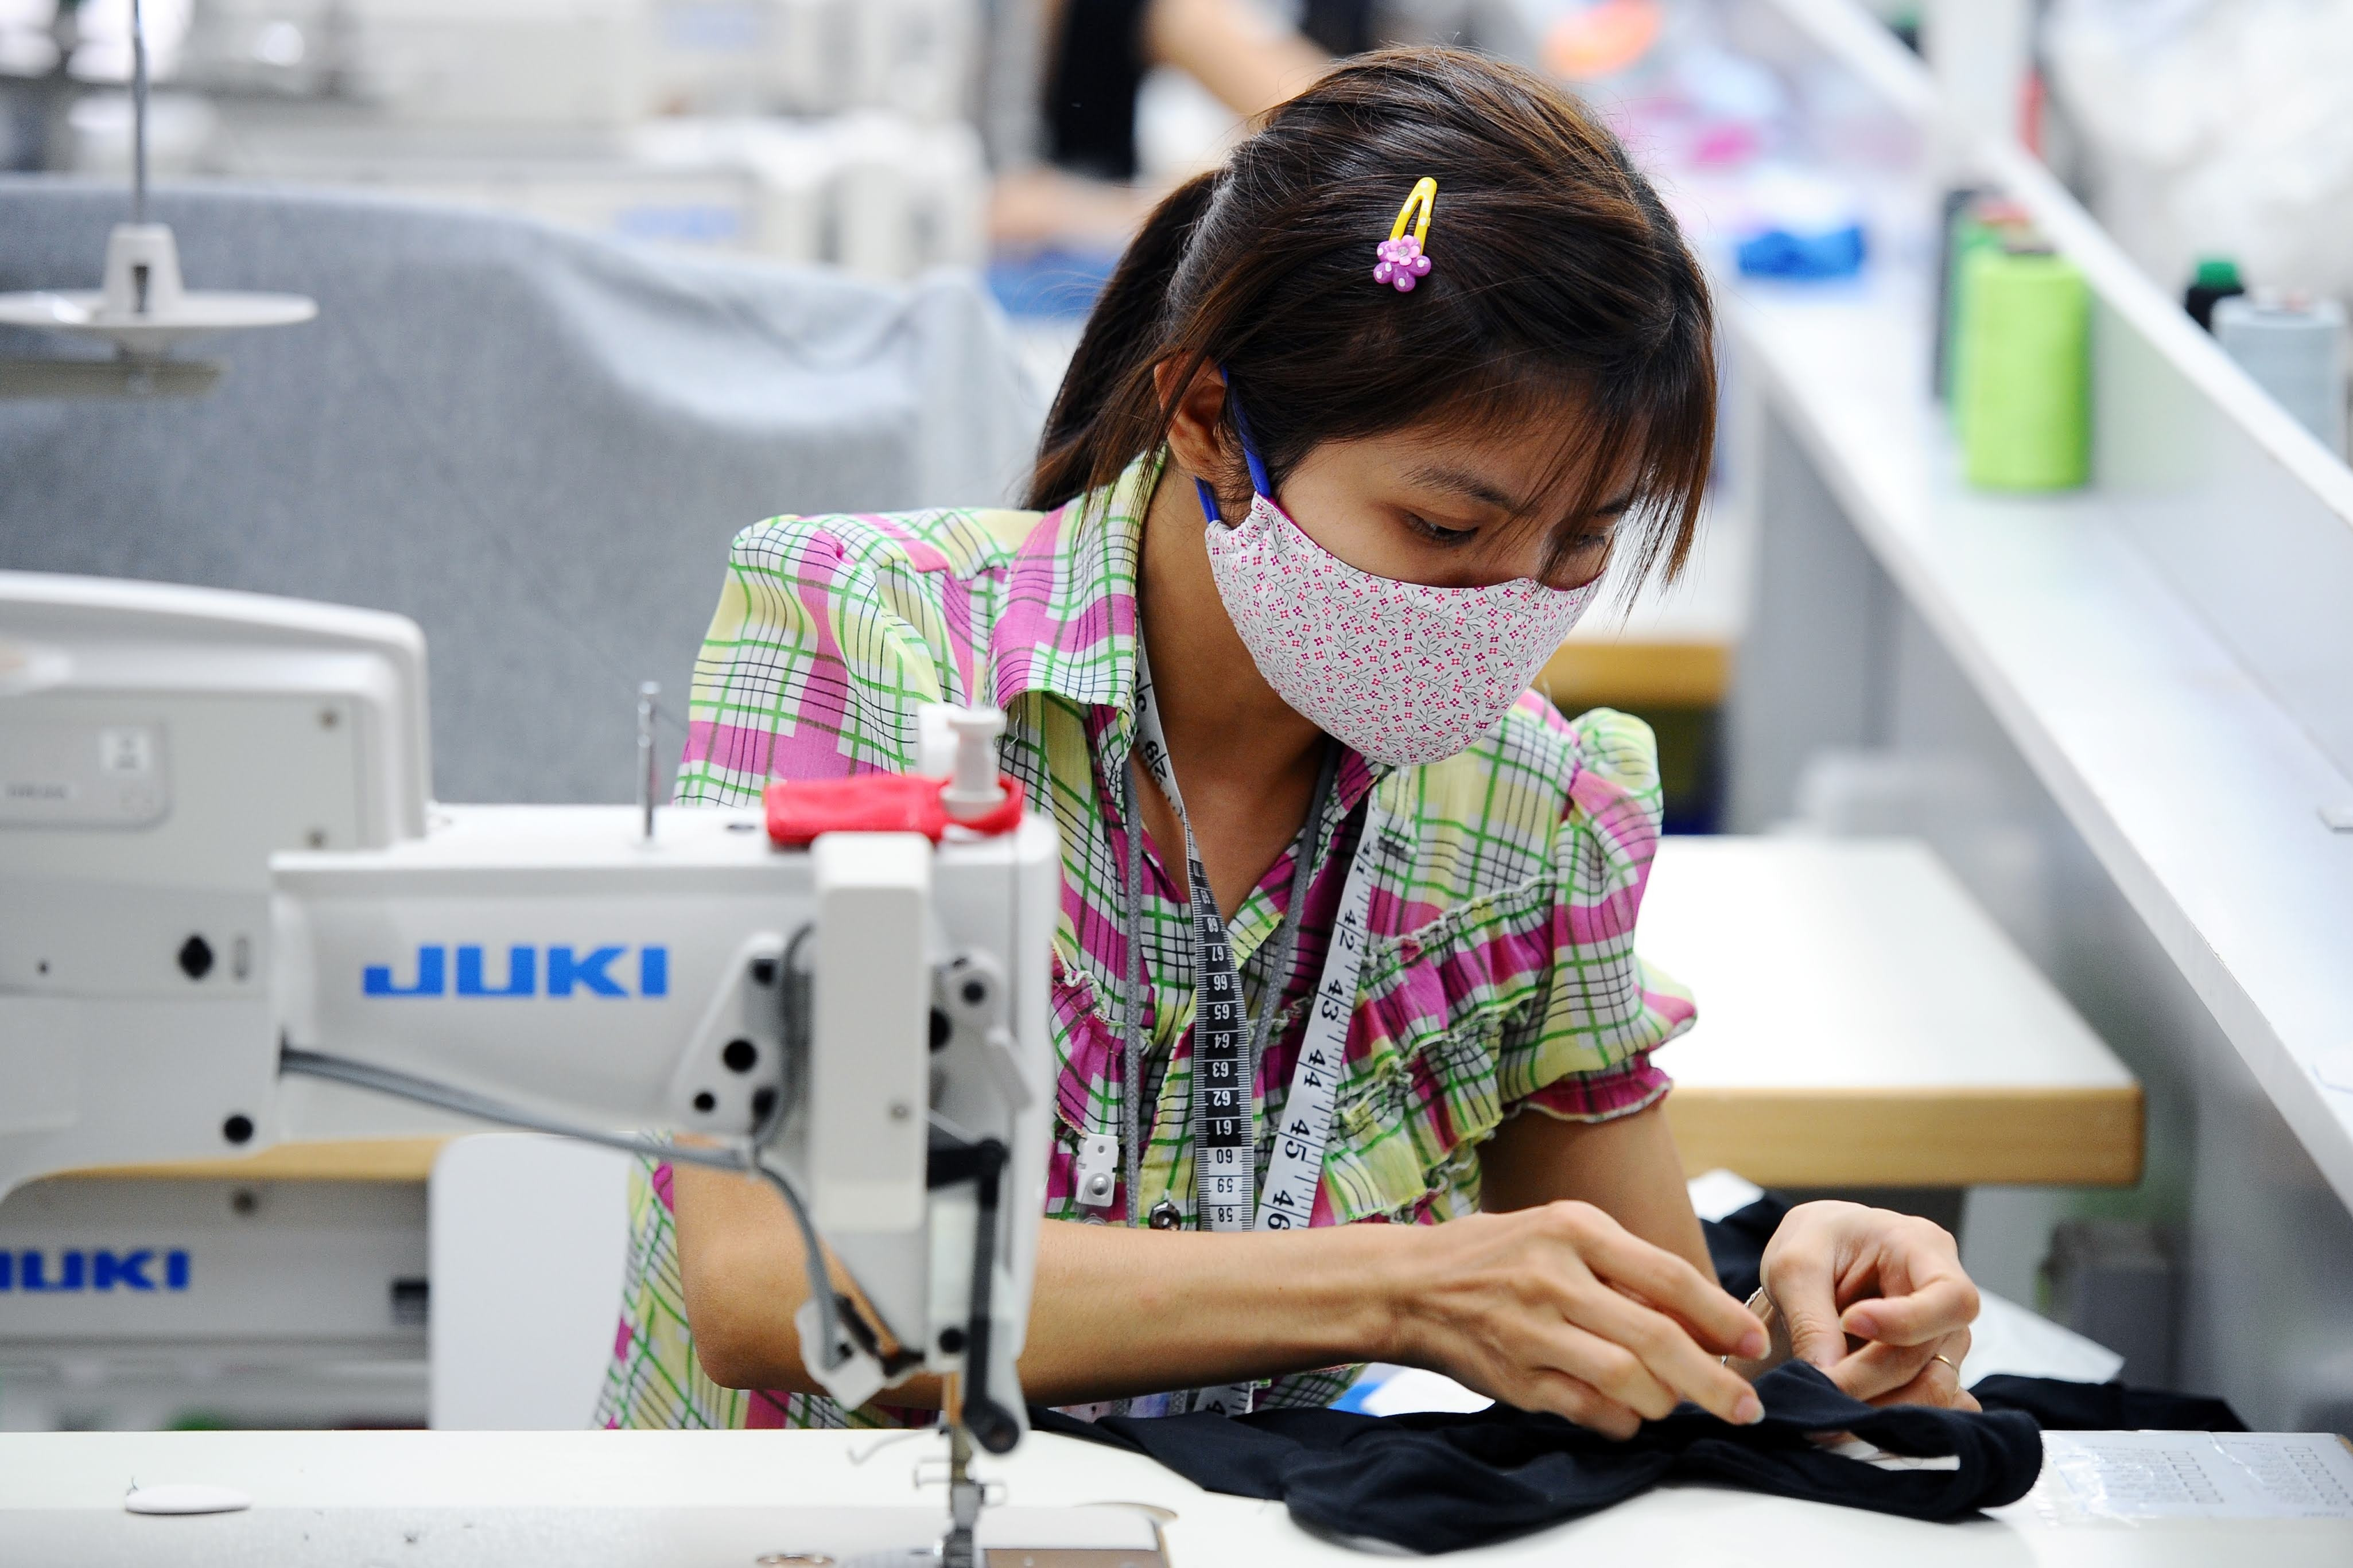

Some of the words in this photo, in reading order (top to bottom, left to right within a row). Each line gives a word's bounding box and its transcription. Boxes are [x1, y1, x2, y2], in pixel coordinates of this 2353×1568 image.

[1339, 909, 1356, 951] 42
[1212, 946, 1224, 962] 67
[364, 947, 666, 996] JUKI
[1213, 975, 1228, 991] 66
[1321, 979, 1344, 1021] 43
[1214, 1004, 1230, 1020] 65
[1214, 1033, 1230, 1048] 64
[1212, 1061, 1229, 1077] 63
[1304, 1049, 1326, 1087] 44
[1213, 1090, 1231, 1106] 62
[1216, 1119, 1232, 1135] 61
[1285, 1119, 1310, 1161] 45
[1216, 1149, 1233, 1164] 60
[1217, 1178, 1233, 1193] 59
[1218, 1207, 1233, 1223] 58
[1268, 1190, 1295, 1230] 46
